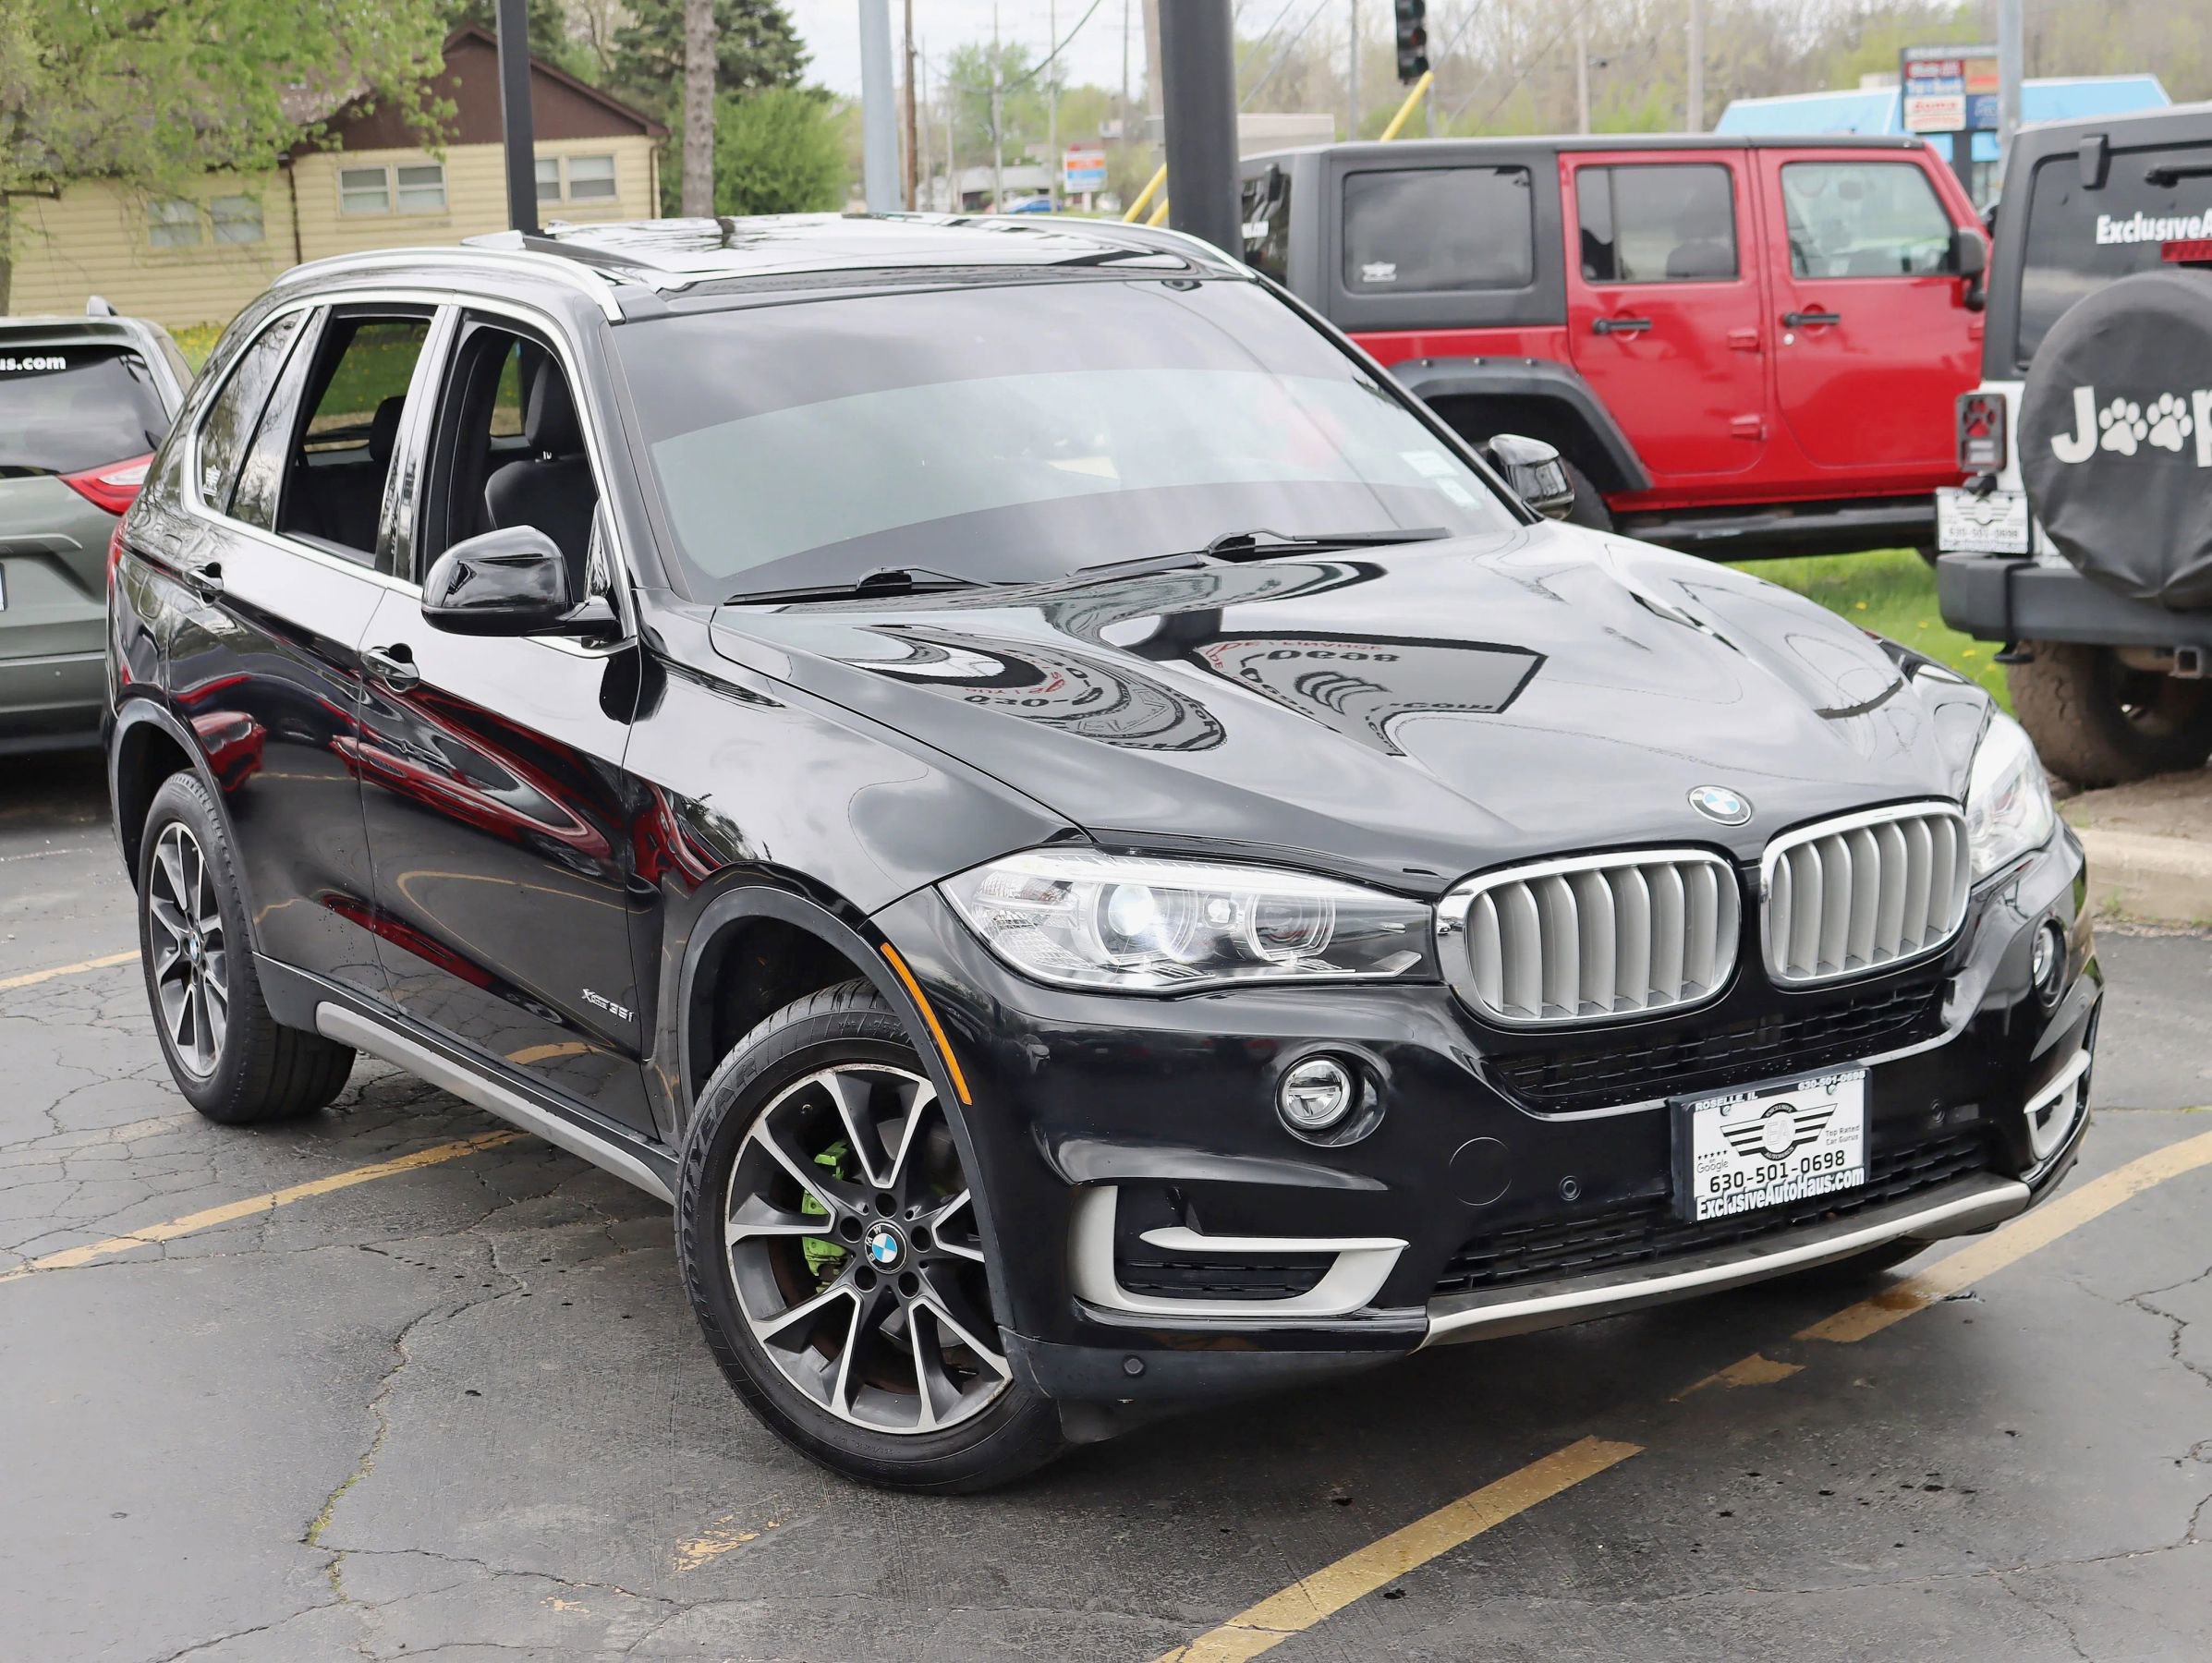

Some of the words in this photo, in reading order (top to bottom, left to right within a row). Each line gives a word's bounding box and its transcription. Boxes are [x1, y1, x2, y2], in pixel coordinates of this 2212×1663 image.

[1797, 1070, 1866, 1091] 630-501-0698
[1695, 1093, 1745, 1111] ROSELLE
[1746, 1091, 1758, 1101] IL
[1839, 1124, 1861, 1135] Rated
[1826, 1137, 1838, 1146] Car
[1696, 1159, 1729, 1174] Google
[1709, 1150, 1845, 1193] 630-501-0698
[1695, 1167, 1865, 1221] ExclusiveAutoHaus.com
[865, 1224, 881, 1262] BMW
